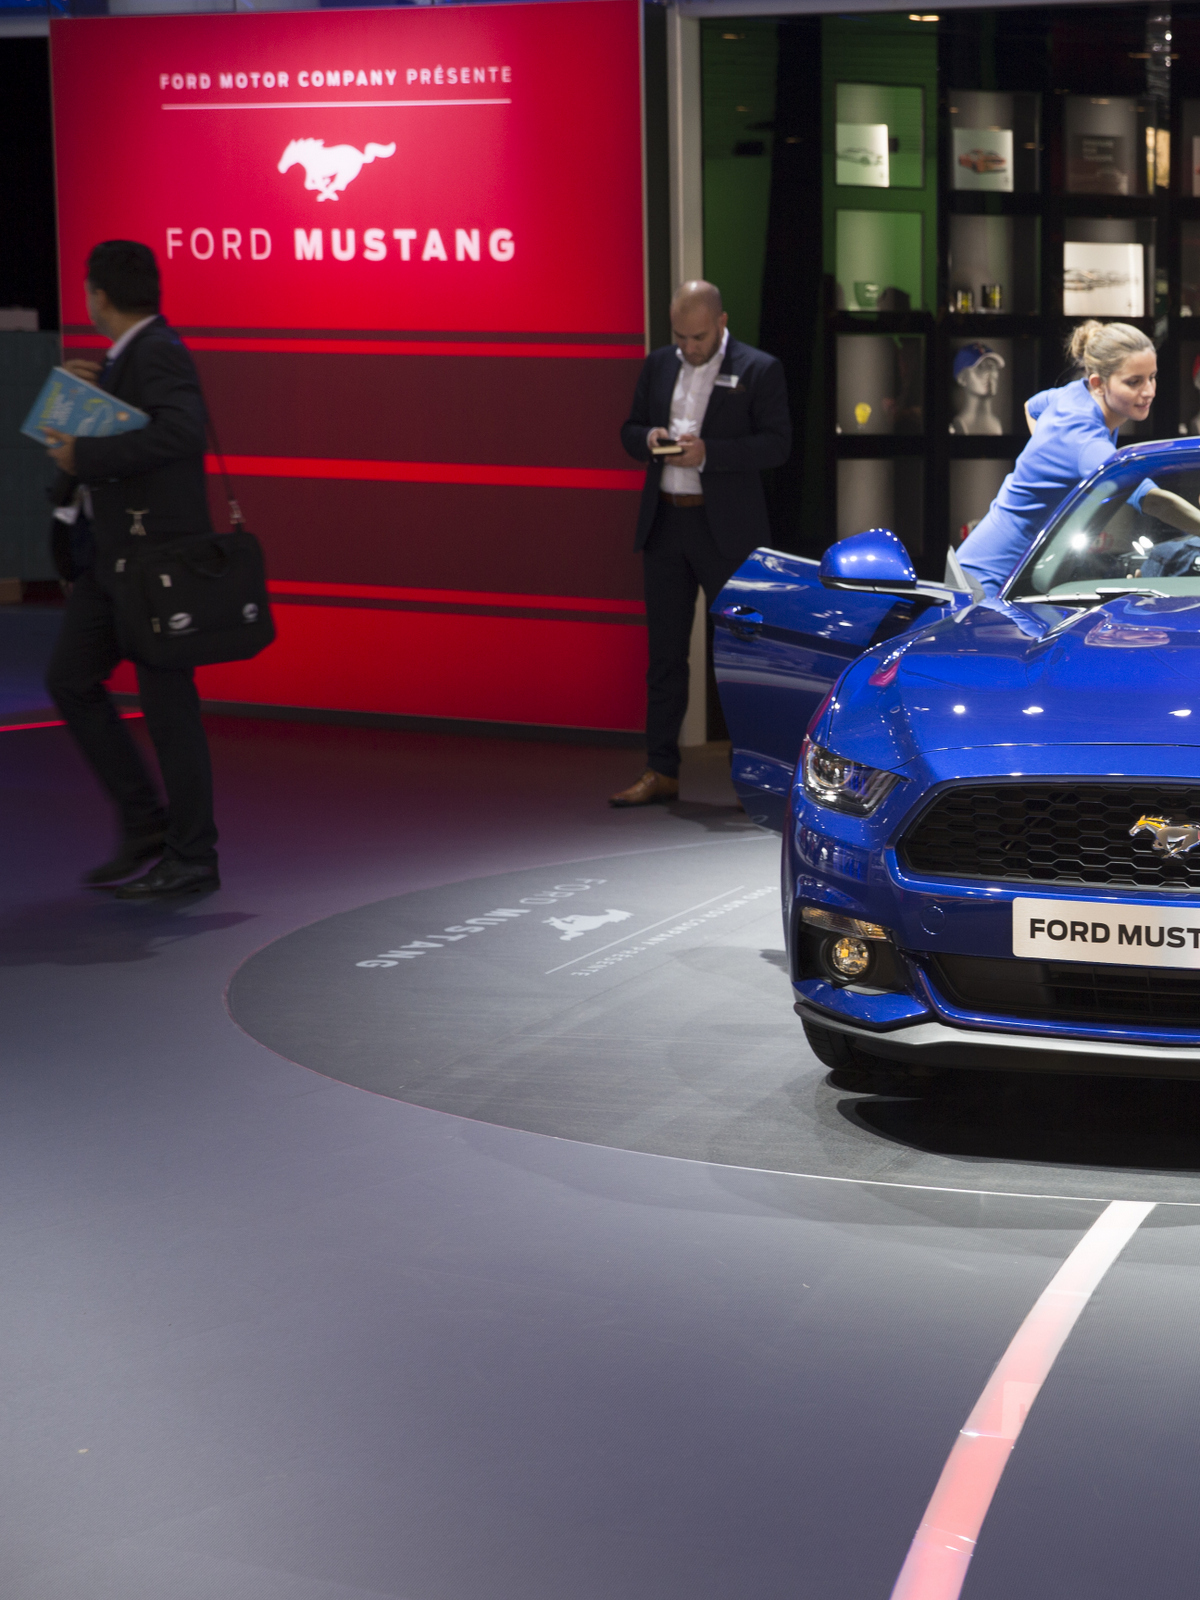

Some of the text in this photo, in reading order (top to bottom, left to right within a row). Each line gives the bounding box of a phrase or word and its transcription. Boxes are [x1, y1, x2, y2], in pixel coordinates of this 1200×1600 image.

[159, 64, 512, 90] FORD MOTOR COMPANY PRÉSENTE
[165, 227, 515, 262] FORD MUSTANG
[355, 877, 608, 968] FORD MUSTANG
[1029, 918, 1110, 944] FORD
